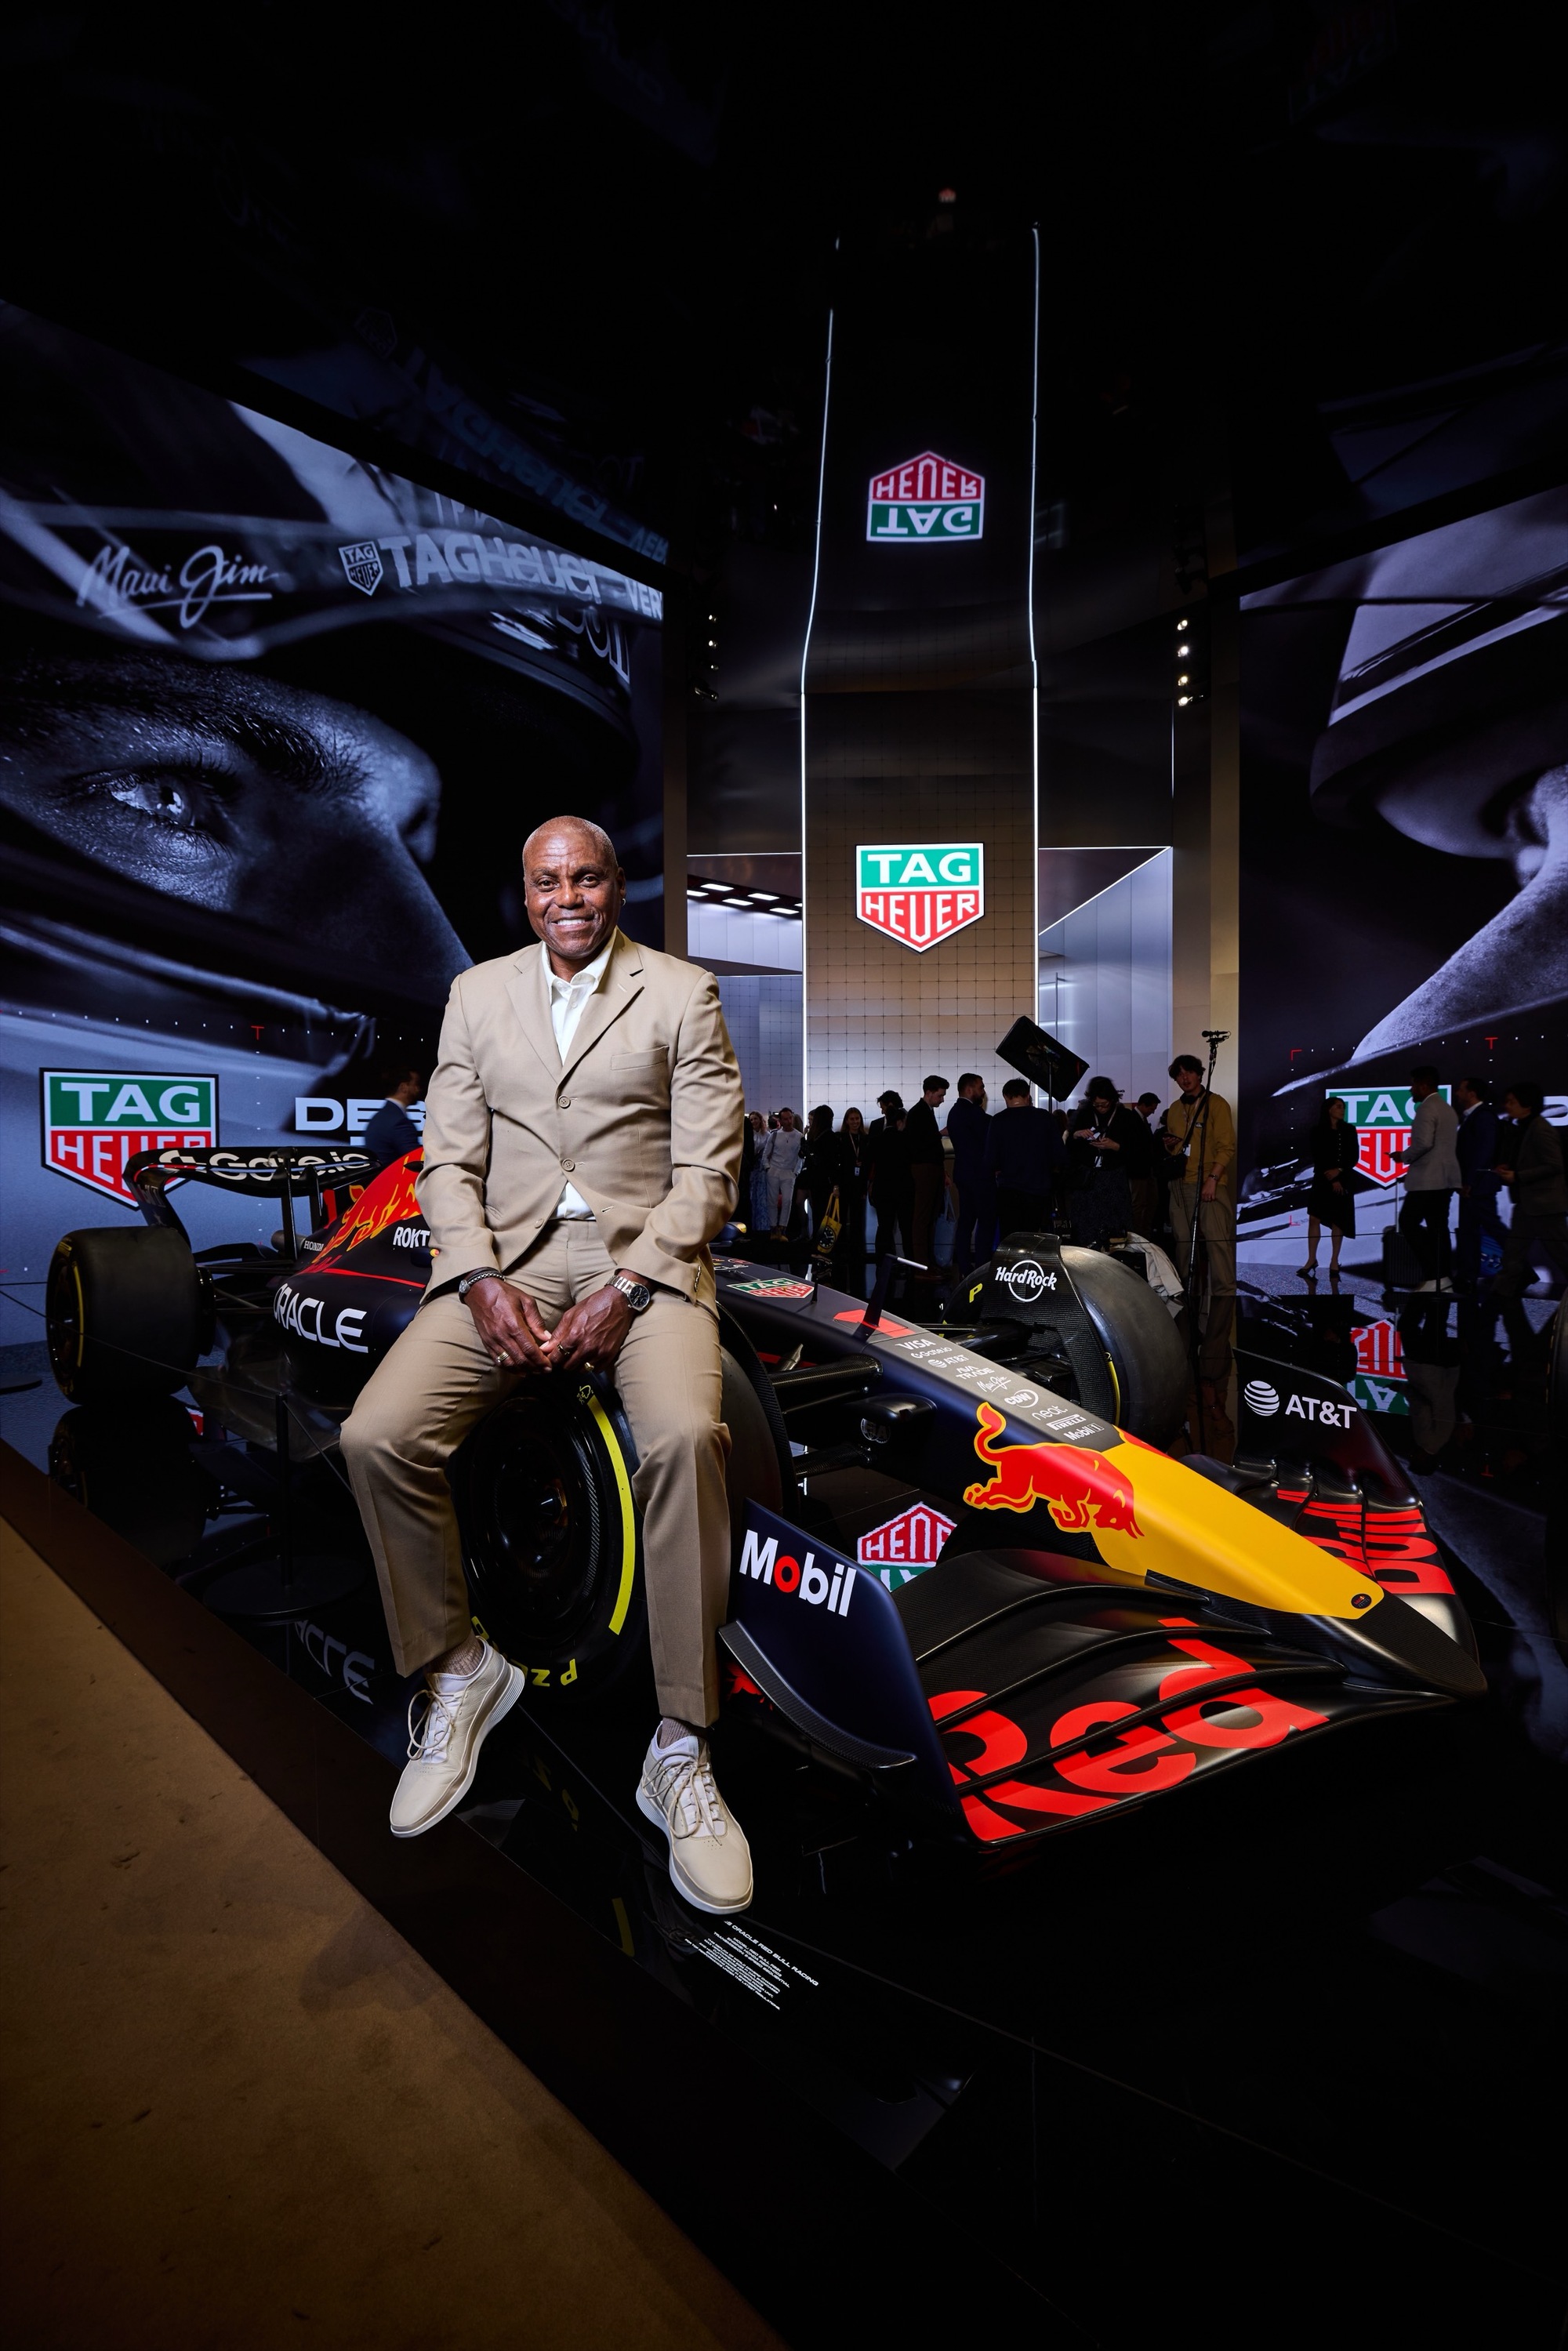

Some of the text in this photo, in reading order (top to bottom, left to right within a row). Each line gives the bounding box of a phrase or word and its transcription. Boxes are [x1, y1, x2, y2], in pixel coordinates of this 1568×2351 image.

[347, 545, 373, 561] TAG
[77, 546, 279, 629] Maui Jim
[349, 562, 379, 594] HEUER
[866, 851, 971, 884] TAG
[866, 891, 976, 943] HEUER
[60, 1082, 201, 1123] TAG
[393, 1226, 431, 1249] ROKT
[737, 1279, 793, 1290] TAG
[273, 1283, 368, 1353] ORACLE
[896, 1338, 936, 1350] VISA
[946, 1355, 970, 1365] AT&T
[956, 1367, 995, 1380] TRADE
[1004, 1392, 1033, 1406] CDW
[1286, 1394, 1358, 1429] AT&T
[1046, 1413, 1087, 1431] PIRELLI
[1063, 1425, 1096, 1441] Mobil
[739, 1529, 857, 1617] Mobil
[732, 1925, 759, 1944] ORACLE
[758, 1943, 773, 1954] RED
[773, 1954, 790, 1967] BULL
[792, 1966, 818, 1986] RACING
